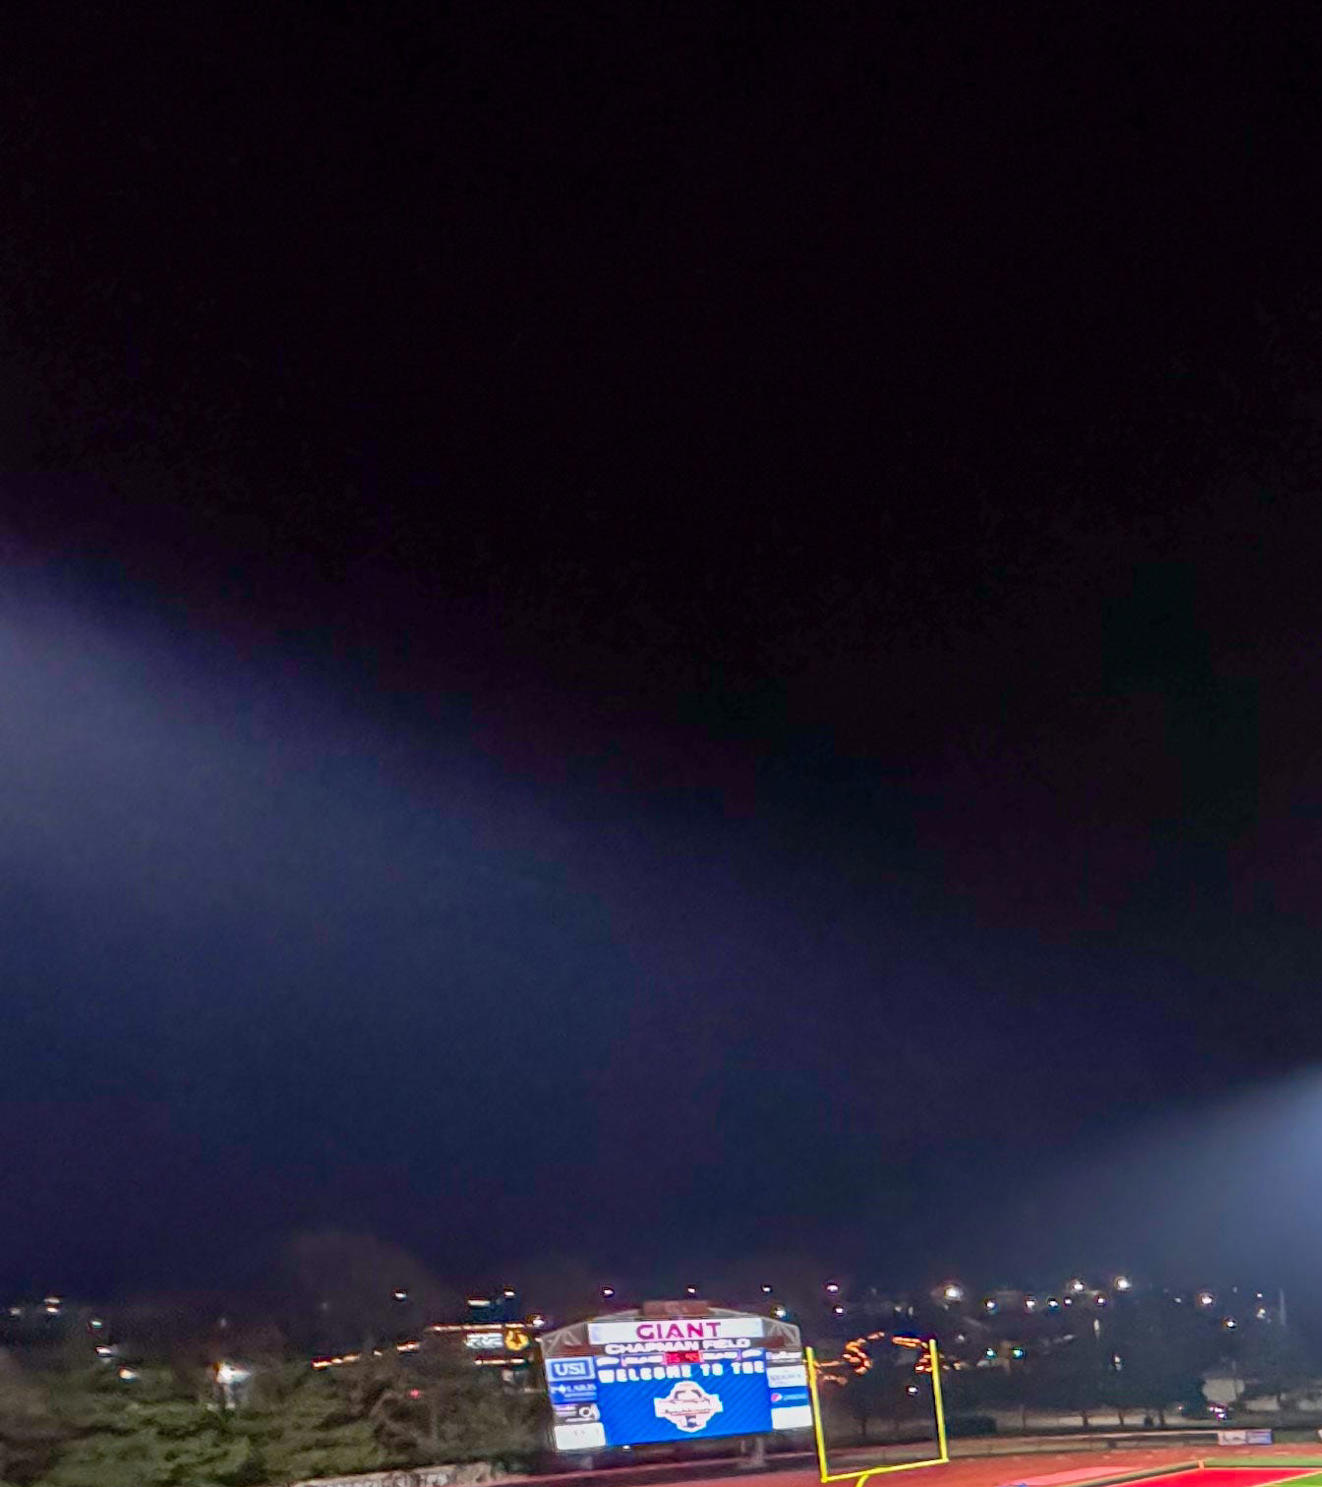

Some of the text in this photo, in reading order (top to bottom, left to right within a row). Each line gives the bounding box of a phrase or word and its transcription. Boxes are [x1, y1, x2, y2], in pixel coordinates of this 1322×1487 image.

[636, 1322, 721, 1340] GIANT
[605, 1338, 751, 1354] CHAPMAN FIELD
[553, 1361, 587, 1376] USI
[598, 1361, 765, 1383] WELCOME TO THE
